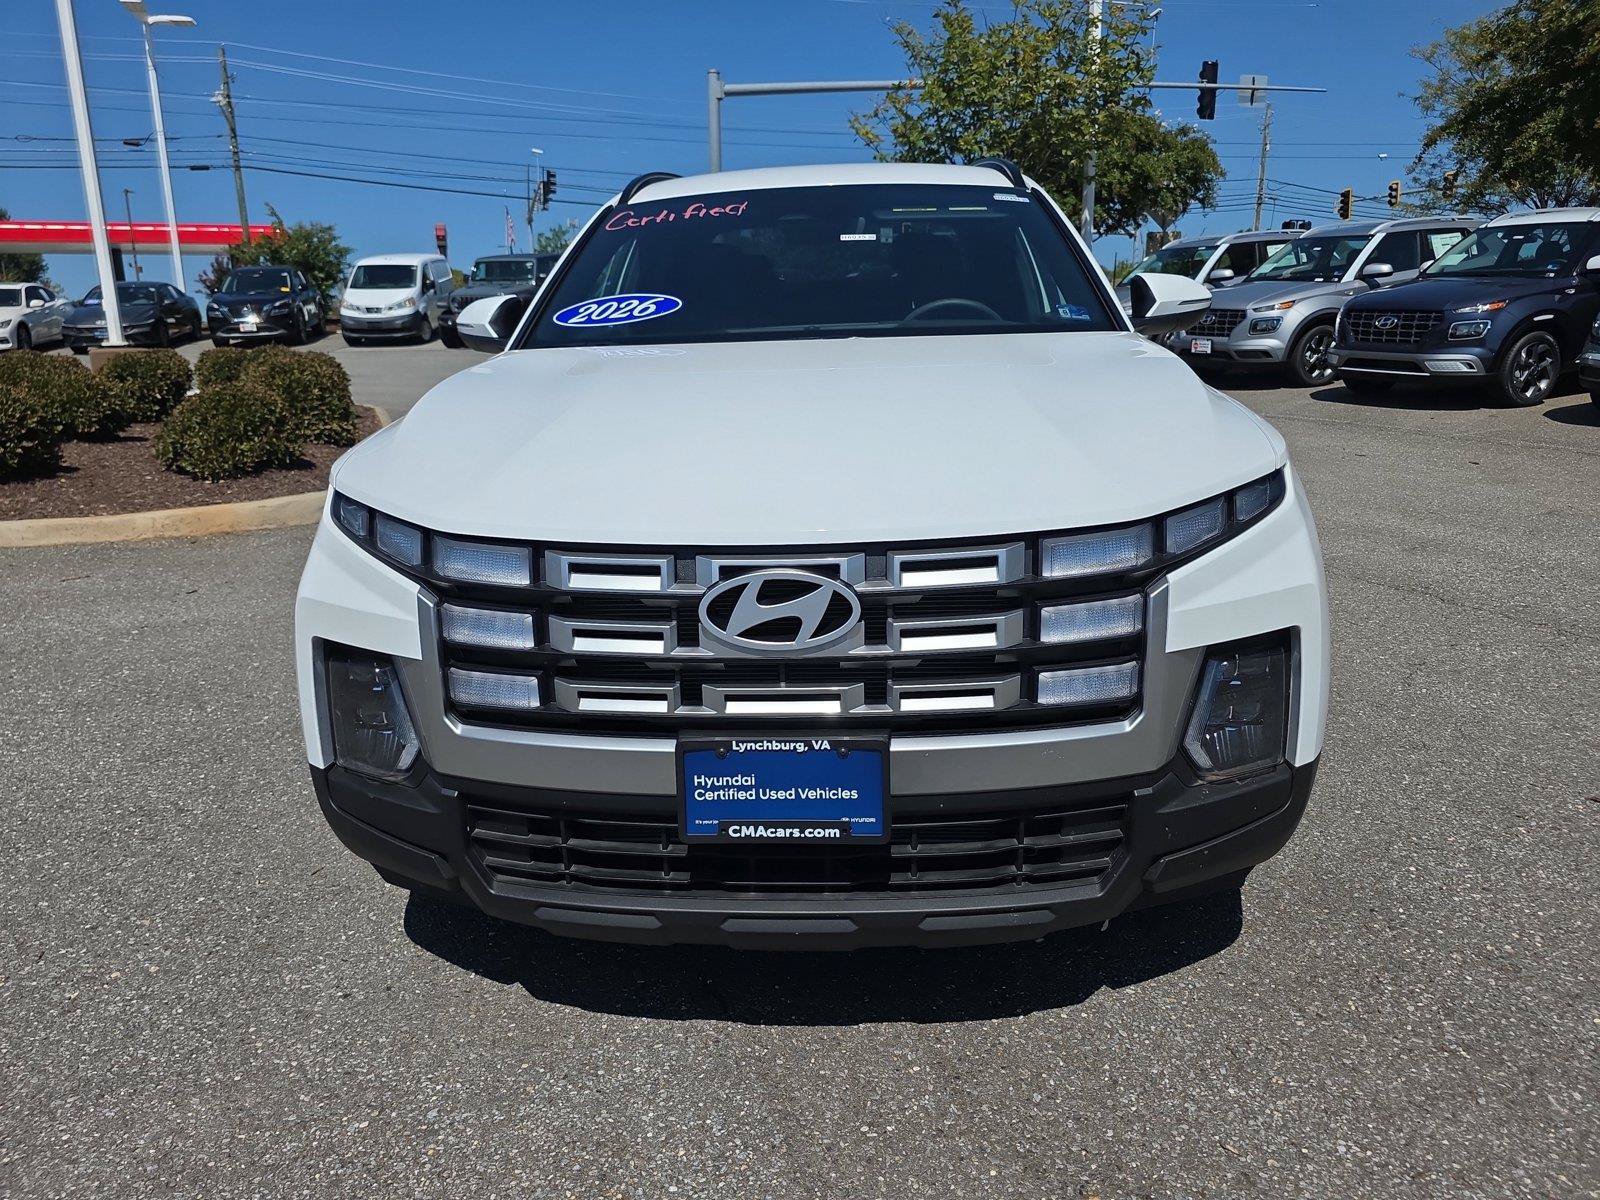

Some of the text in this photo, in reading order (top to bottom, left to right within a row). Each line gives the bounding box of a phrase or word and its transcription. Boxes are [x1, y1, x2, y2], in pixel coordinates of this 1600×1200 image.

[605, 201, 748, 231] Certified
[567, 297, 665, 324] 2026
[732, 740, 831, 752] Lynchburg, VA
[694, 774, 755, 788] Hyundai
[694, 788, 859, 800] Certified Used Vehicles
[728, 826, 840, 838] CMAcars.com
